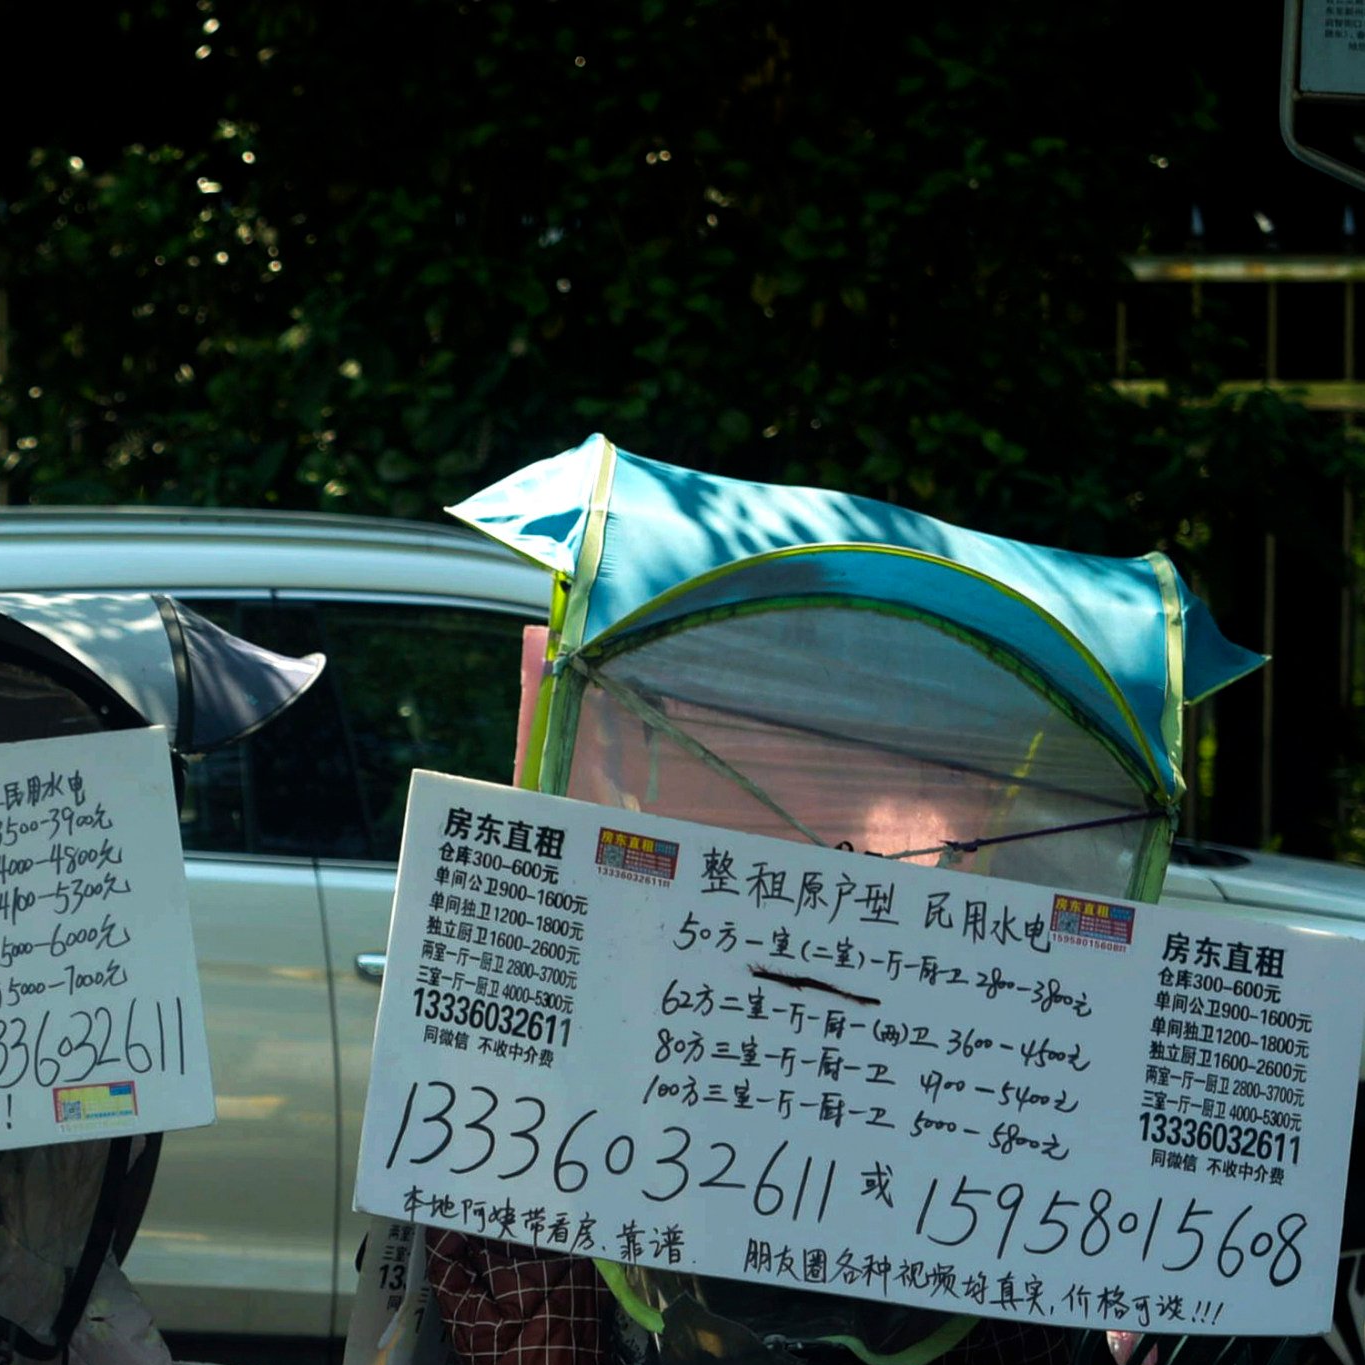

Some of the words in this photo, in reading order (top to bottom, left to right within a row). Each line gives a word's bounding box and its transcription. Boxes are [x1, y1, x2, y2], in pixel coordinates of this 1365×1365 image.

[443, 807, 565, 860] 房东直租
[437, 841, 560, 885] 仓库300-600元
[434, 866, 589, 916] 单间公卫900-1600元
[700, 847, 899, 925] 整租原户型
[924, 892, 1051, 955] 民用水电
[428, 891, 584, 941] 单间独卫1200-1800元
[426, 915, 581, 966] 独立厨卫1600-2600元
[1162, 932, 1285, 979] 房东直租
[421, 939, 504, 976] 两室一厅一厨卫
[505, 957, 578, 990] 2800-3700元
[1158, 967, 1281, 1003] 仓库300-600元
[416, 966, 499, 999] 三室一厅一厨卫
[502, 980, 573, 1014] 4000-5300元
[1154, 991, 1313, 1033] 单间公卫900-1600元
[413, 987, 572, 1047] 13336032611
[1150, 1017, 1310, 1059] 单间独卫1200-1800元
[423, 1024, 469, 1051] 同微信
[478, 1035, 554, 1068] 不收中介费
[1148, 1041, 1307, 1083] 独立厨卫1600-2600元
[1145, 1064, 1230, 1095] 两室一厅一厨卫
[1232, 1078, 1305, 1107] 2800-3700元
[1141, 1089, 1227, 1120] 三室一厅一厨卫
[1229, 1103, 1302, 1132] 4000-5300元
[1139, 1112, 1300, 1165] 13336032611
[386, 1081, 837, 1223] 13336032611
[861, 1162, 894, 1208] 或
[916, 1178, 1308, 1288] 15958015608
[1151, 1148, 1197, 1173] 同微信
[1206, 1157, 1285, 1186] 不收中介费
[380, 1264, 407, 1289] 13
